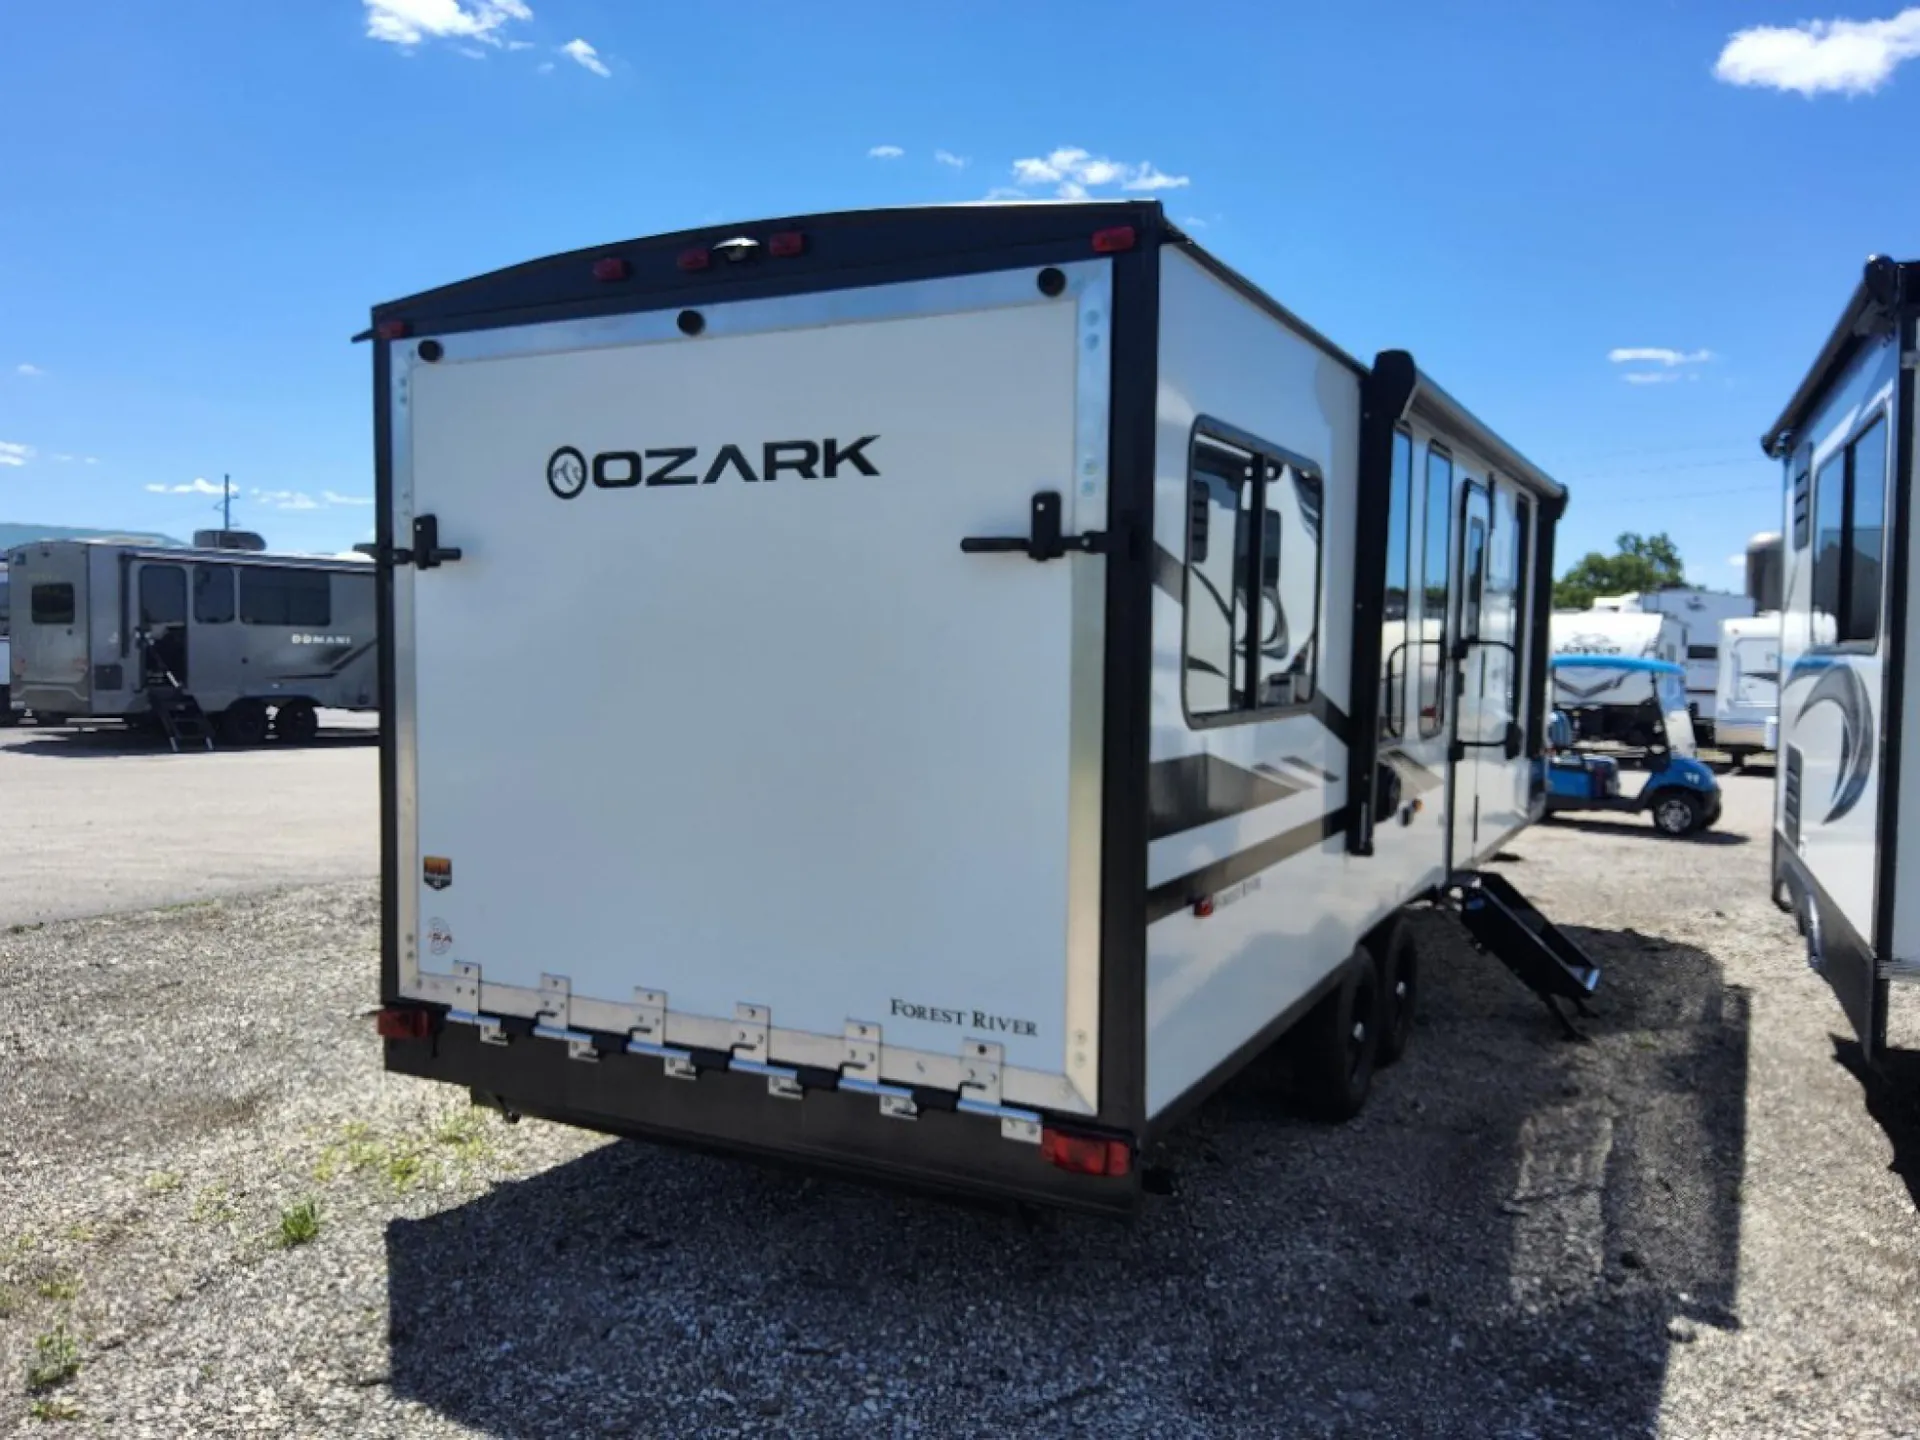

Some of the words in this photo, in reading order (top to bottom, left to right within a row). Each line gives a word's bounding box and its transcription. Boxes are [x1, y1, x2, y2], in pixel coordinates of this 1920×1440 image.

[592, 434, 881, 489] OZARK
[291, 632, 352, 645] DOMANI
[889, 998, 967, 1027] FOREST
[971, 1010, 1039, 1038] RIVER
